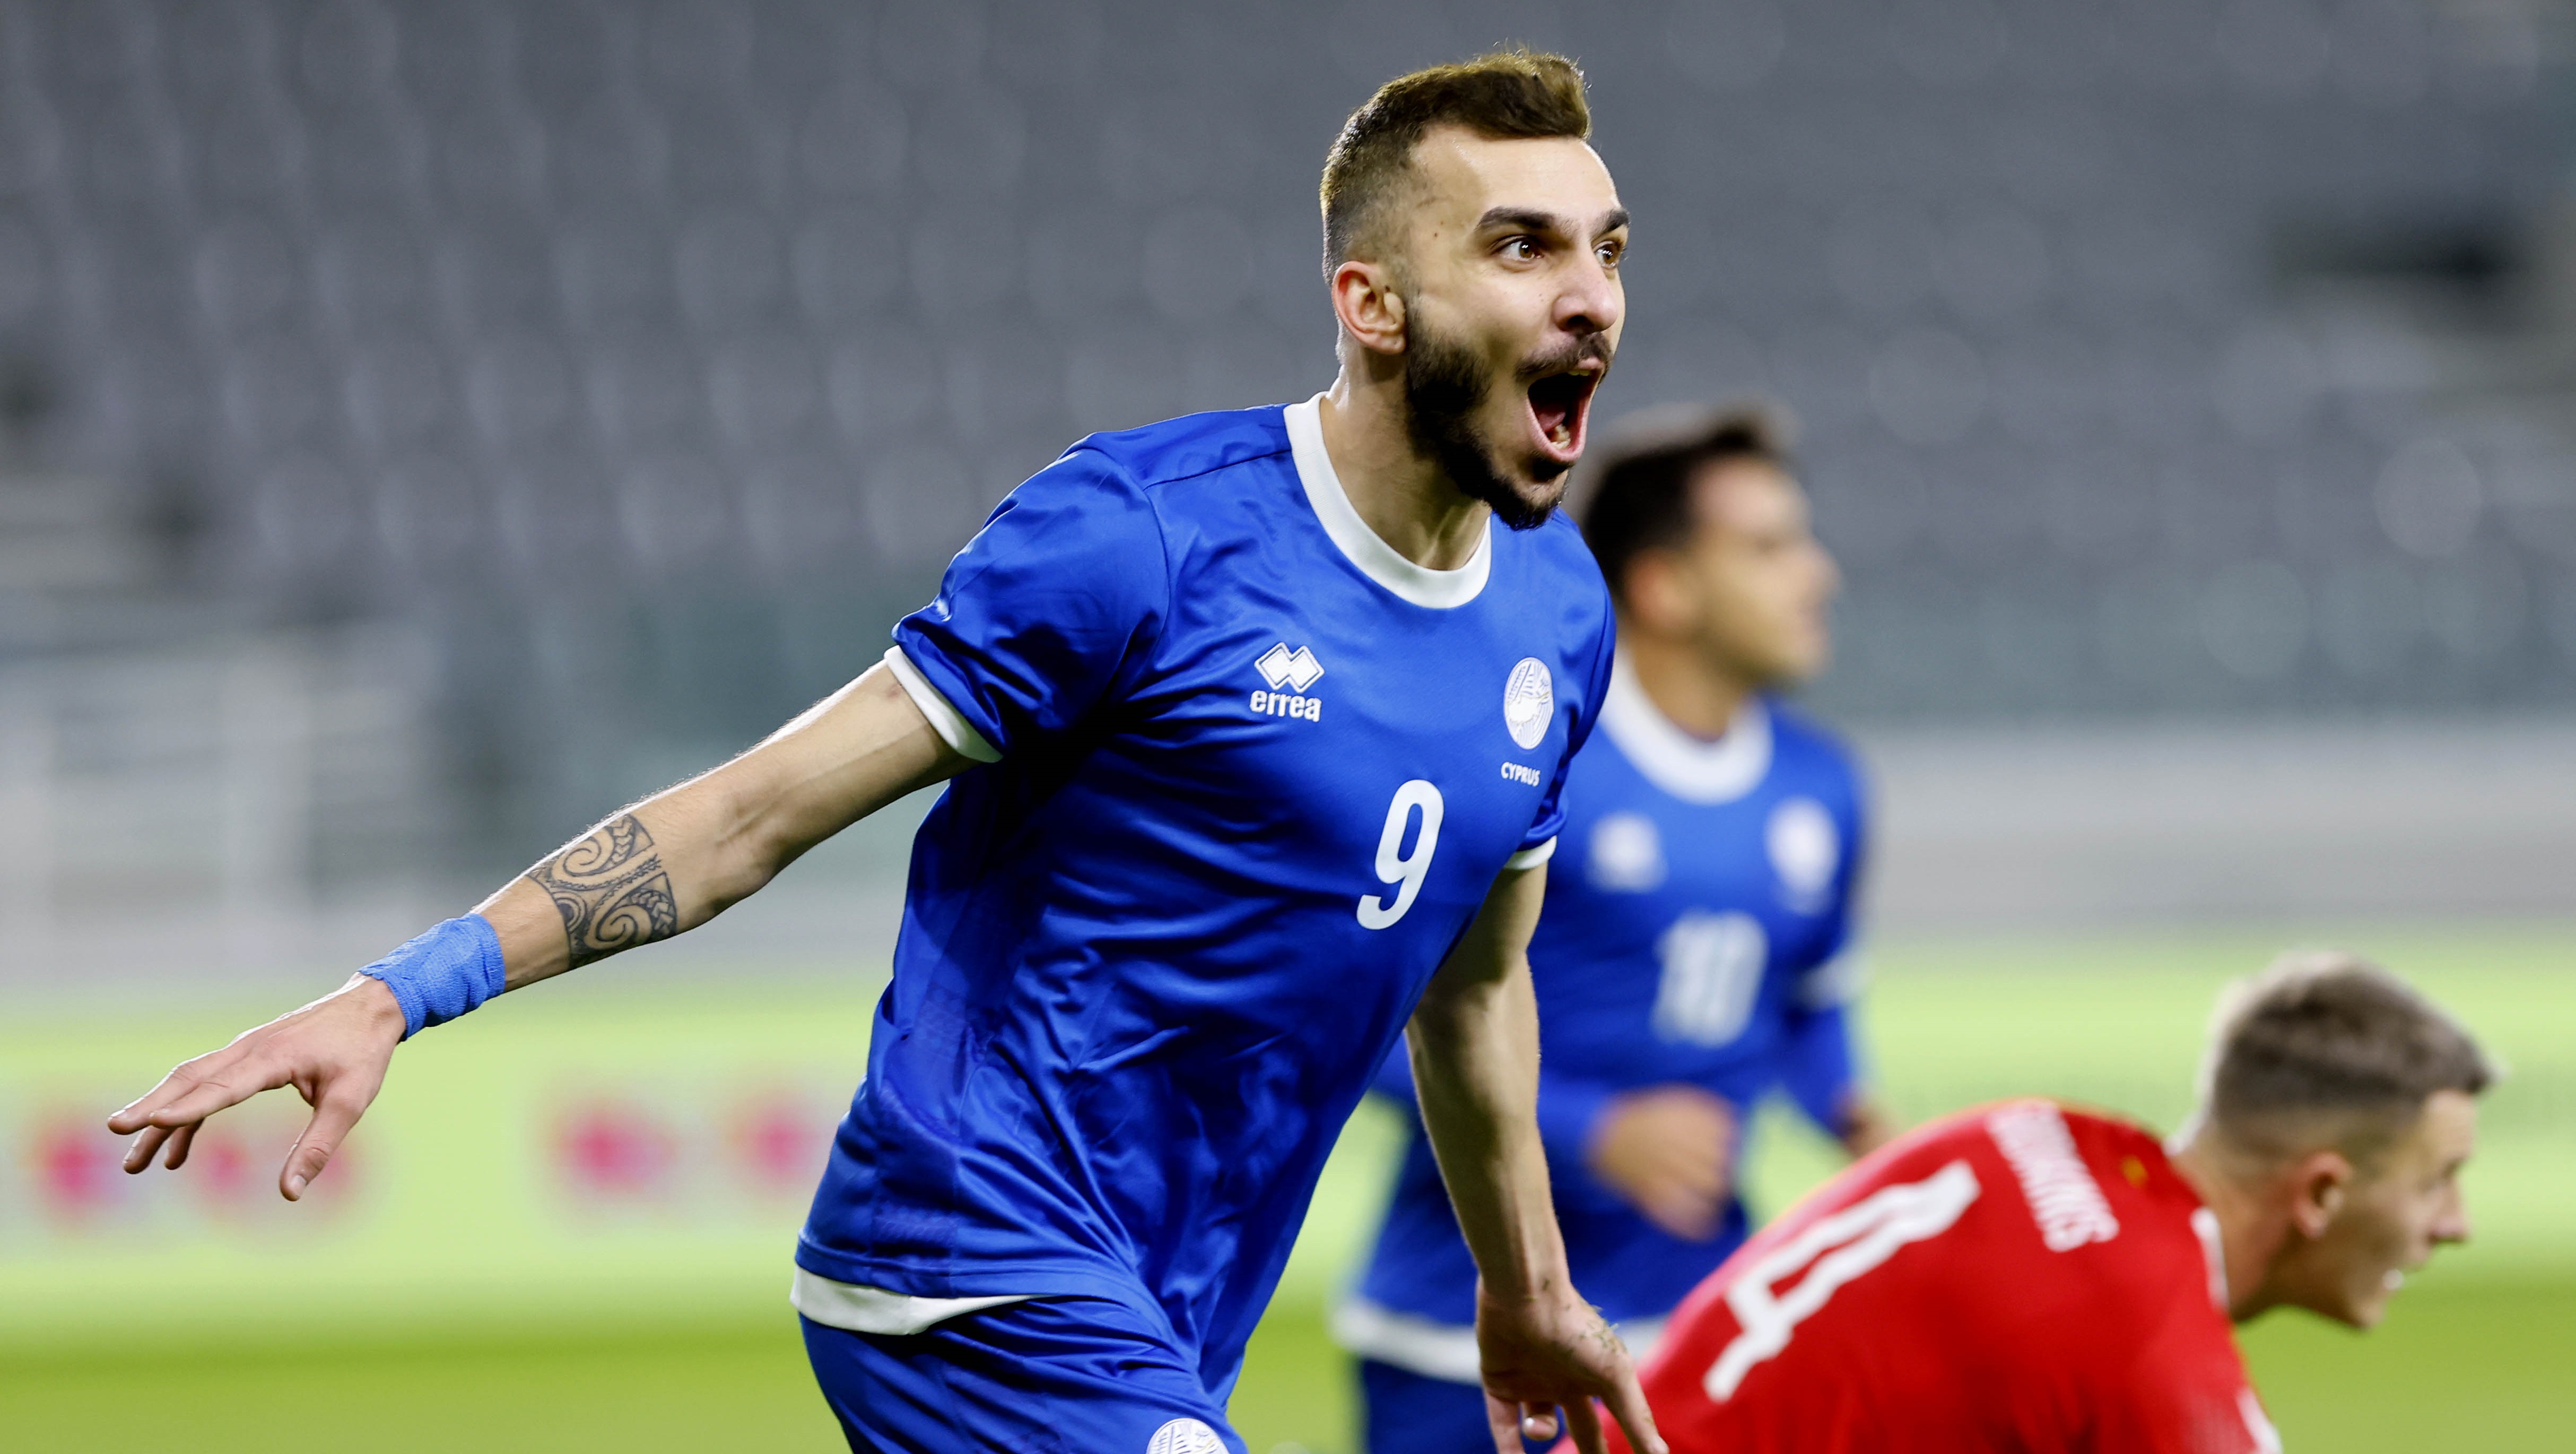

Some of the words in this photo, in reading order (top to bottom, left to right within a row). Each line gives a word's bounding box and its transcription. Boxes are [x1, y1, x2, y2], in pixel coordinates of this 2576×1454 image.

[1250, 690, 1322, 722] errea
[1501, 761, 1541, 786] CYPRUS
[1356, 779, 1444, 930] 9
[1703, 1159, 1982, 1404] 4
